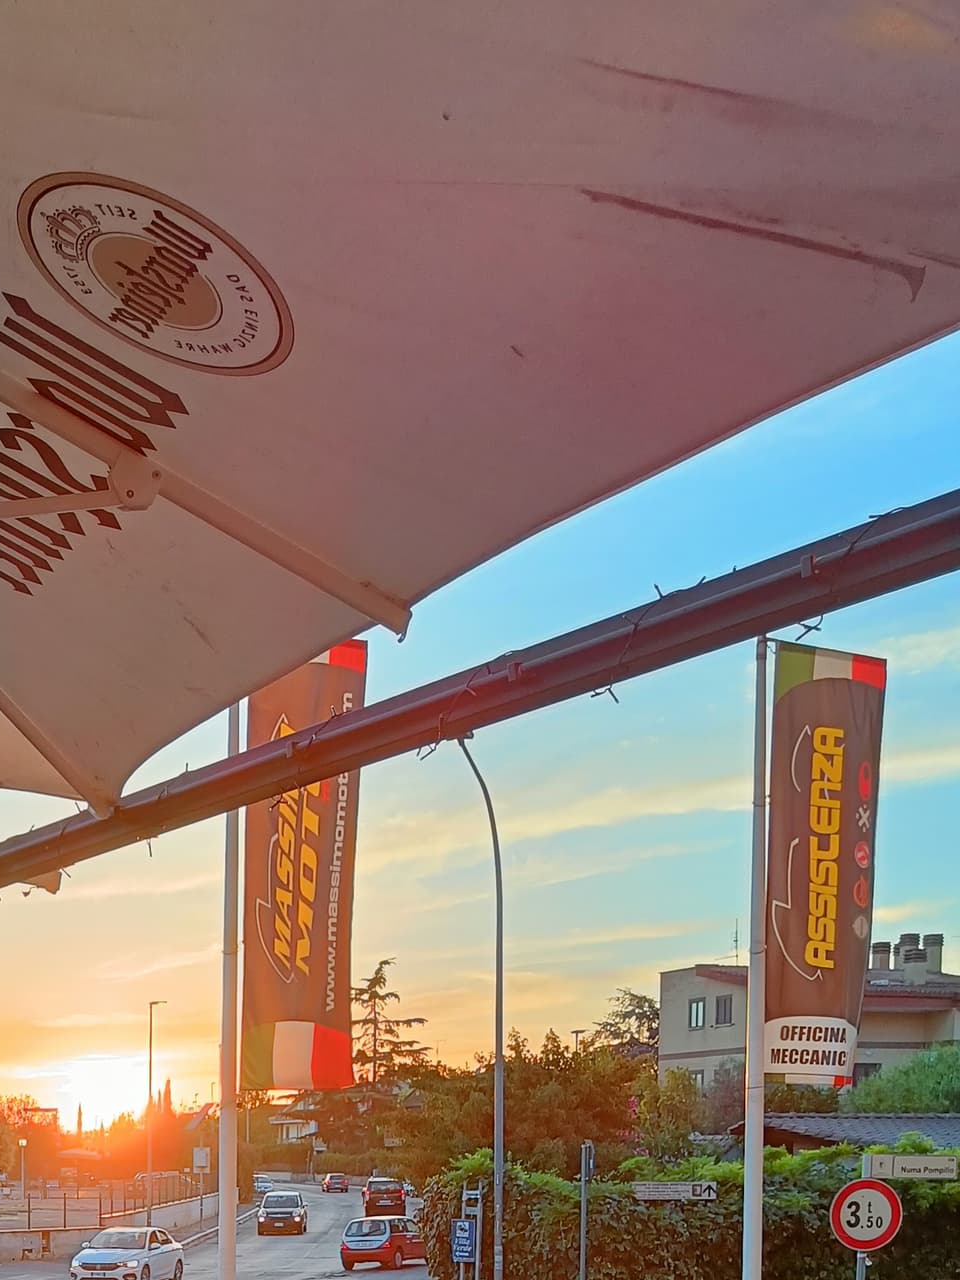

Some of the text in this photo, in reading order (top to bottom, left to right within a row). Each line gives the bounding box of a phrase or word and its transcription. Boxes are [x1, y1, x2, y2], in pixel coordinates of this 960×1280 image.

[271, 721, 300, 970] MASSIM
[295, 779, 322, 977] MOT
[804, 726, 845, 970] ASSISTENZA
[770, 1048, 847, 1067] MECCANIC
[780, 1025, 847, 1044] OFFICINA
[900, 1166, 955, 1175] Numa Pompilio
